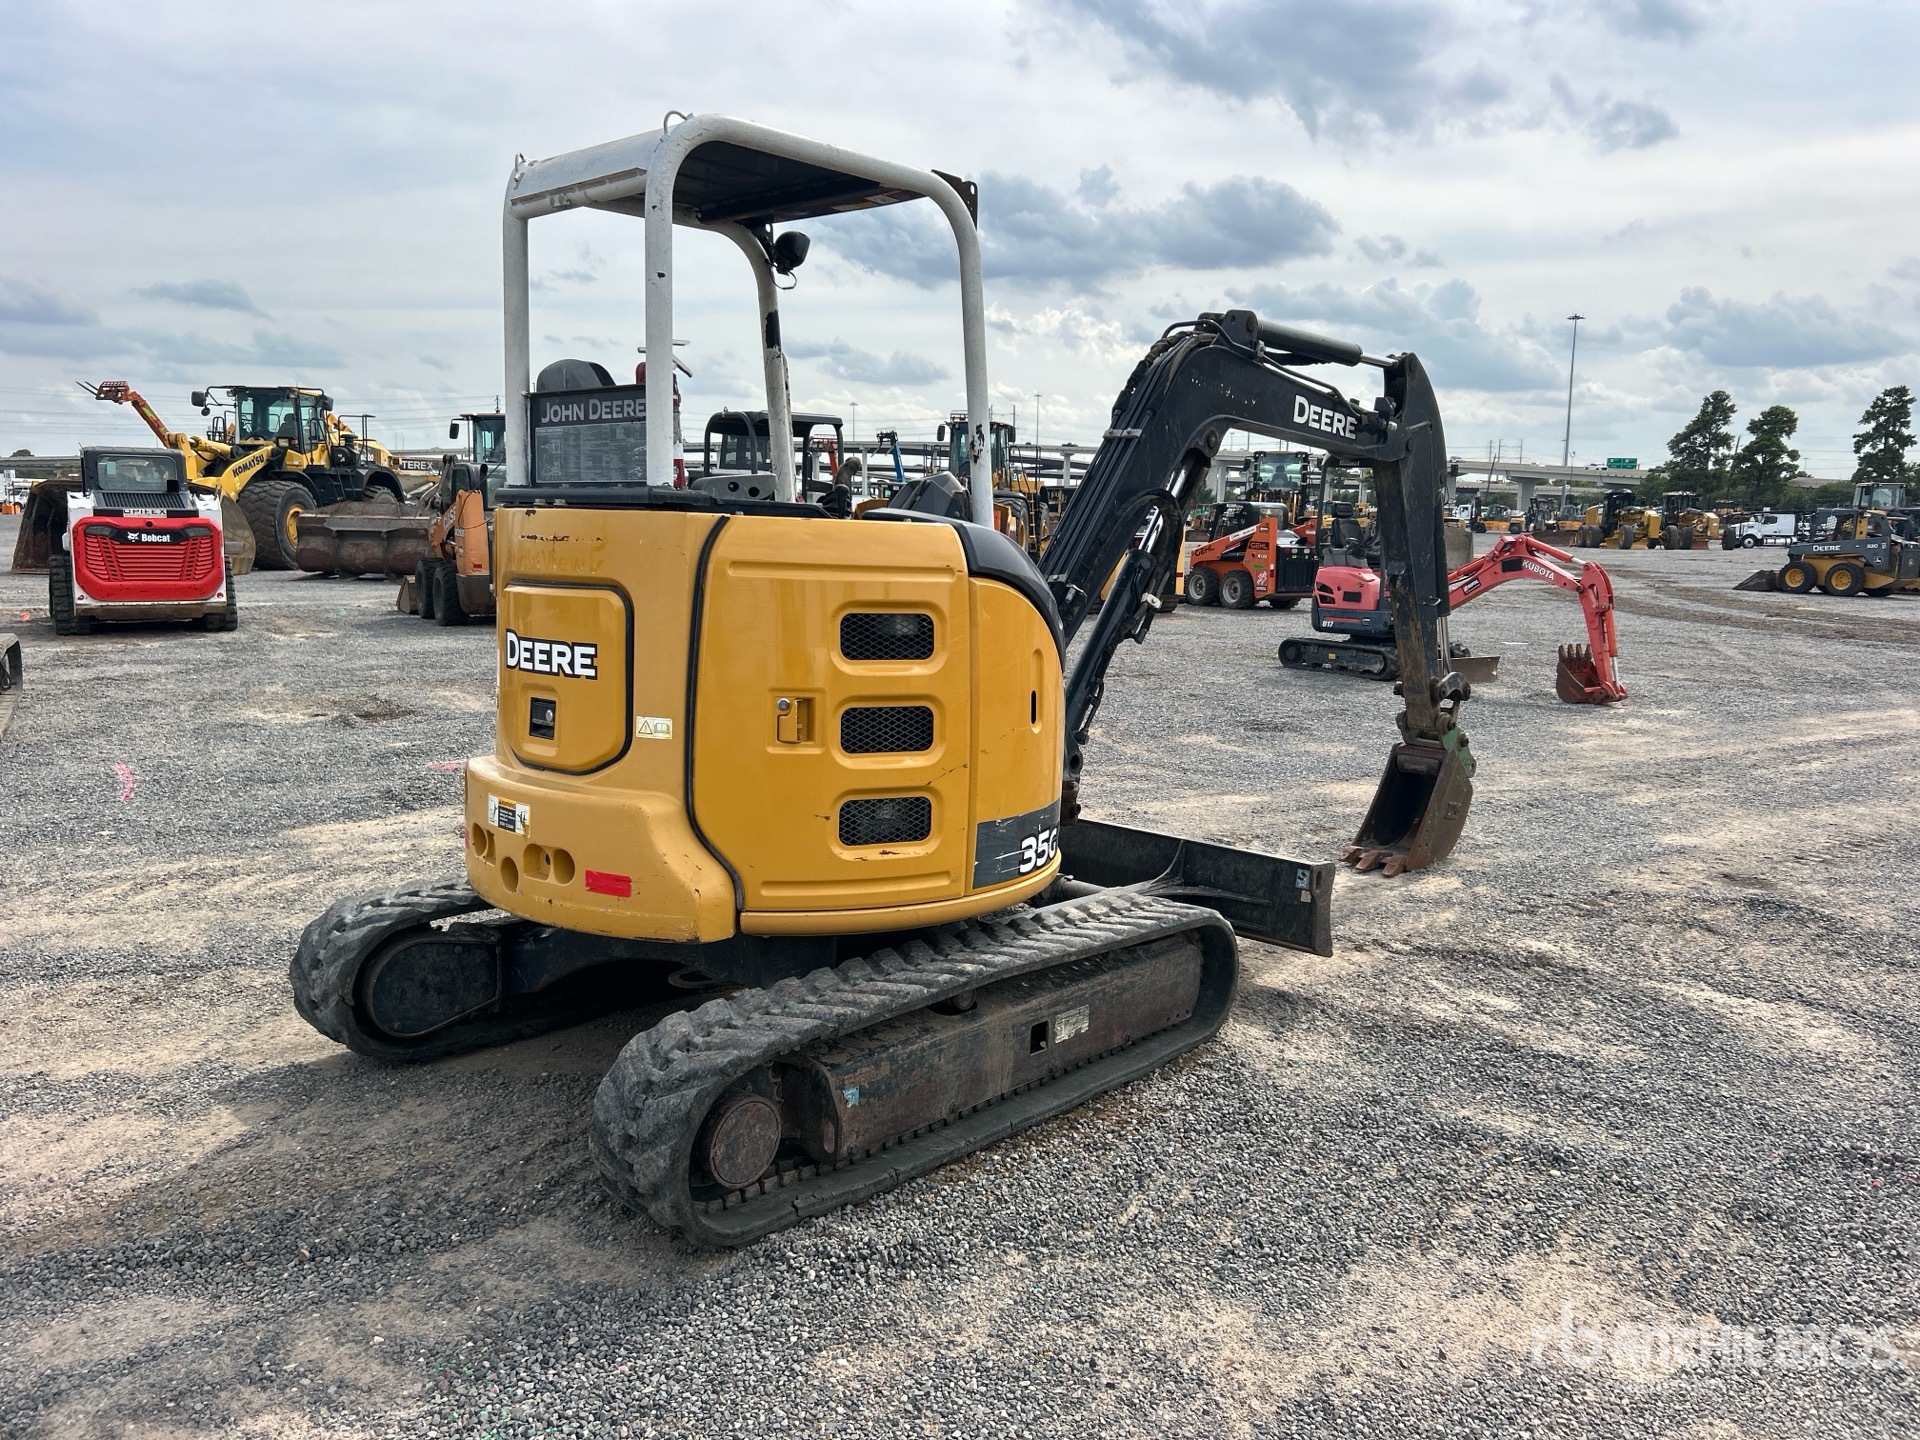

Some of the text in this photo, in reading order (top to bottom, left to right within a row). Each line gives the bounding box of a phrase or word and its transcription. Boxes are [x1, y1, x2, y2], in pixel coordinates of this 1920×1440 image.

[541, 398, 647, 424] JOHN DEERE
[1293, 394, 1357, 440] DEERE
[232, 453, 265, 478] KOMATSU
[402, 460, 433, 470] TEREX
[141, 533, 171, 543] Bobcat
[1812, 544, 1842, 552] DEERE
[1194, 545, 1215, 557] GEHL
[1521, 559, 1555, 581] KUBOTA
[506, 630, 597, 679] DEERE
